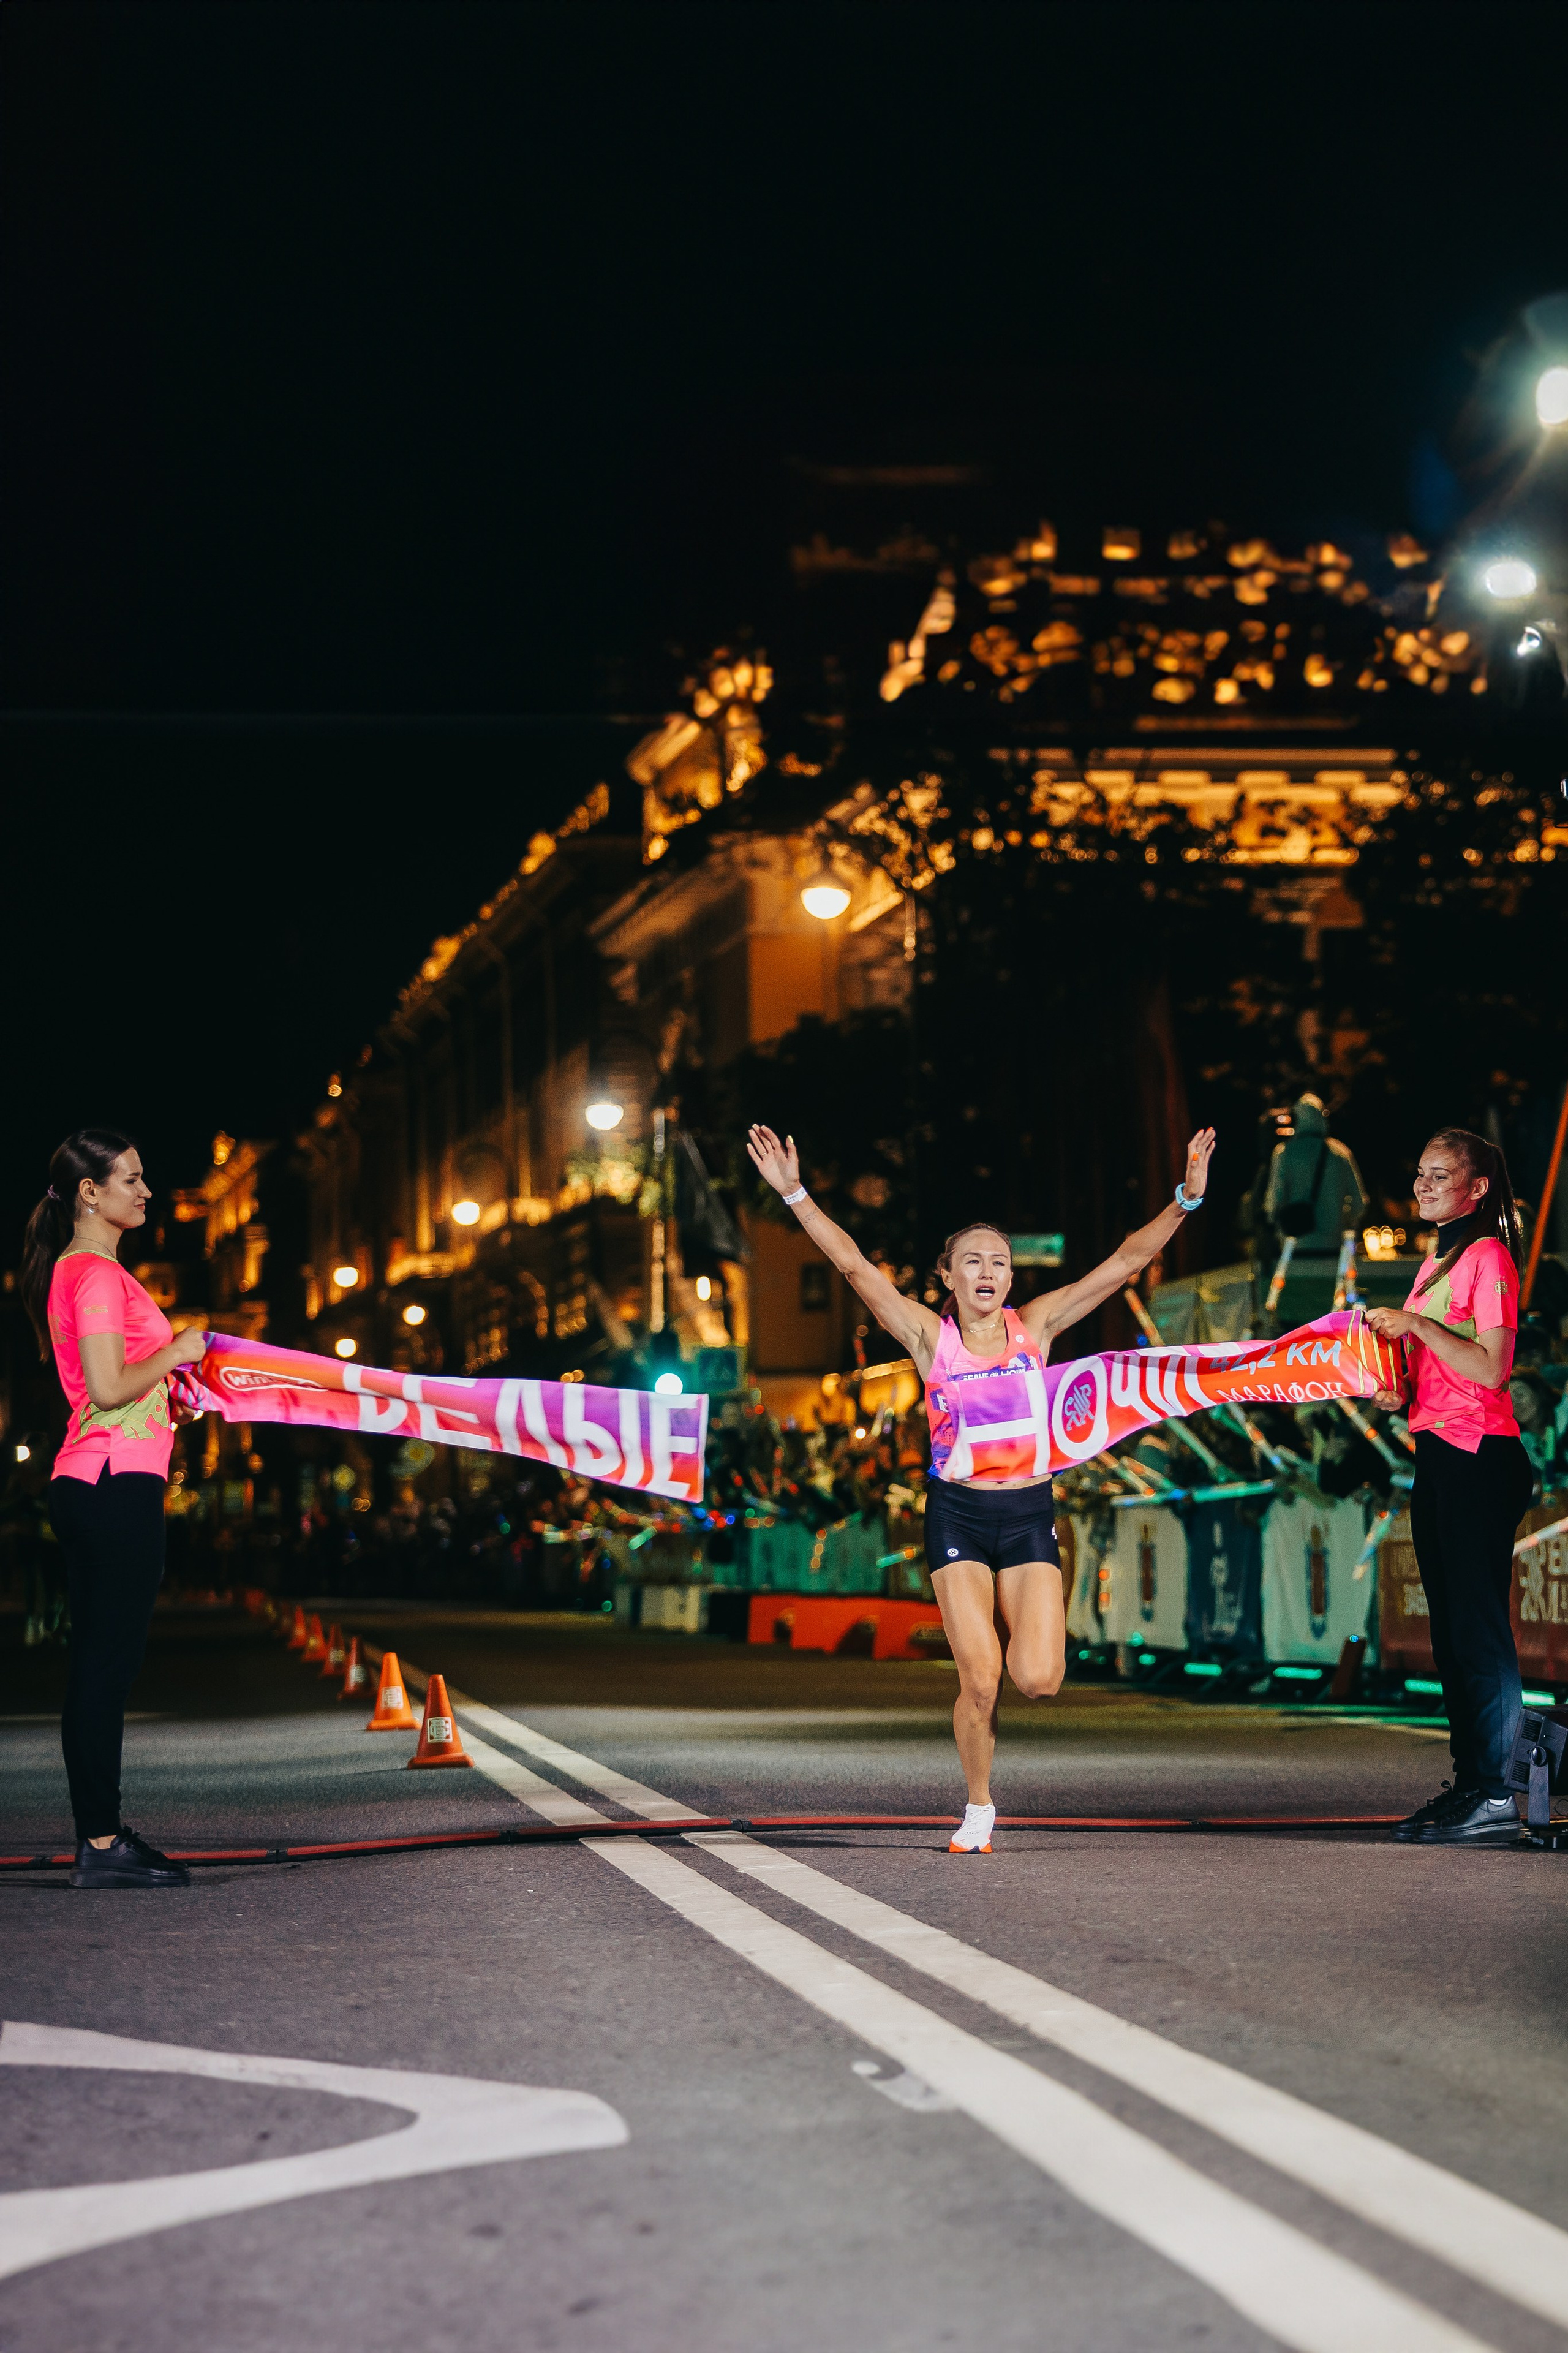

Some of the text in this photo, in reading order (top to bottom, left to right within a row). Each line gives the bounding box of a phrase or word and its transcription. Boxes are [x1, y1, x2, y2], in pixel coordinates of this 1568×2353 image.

[344, 1364, 699, 1497] БЕЛЫЕ
[943, 1353, 1218, 1480] НОЧИ
[1215, 1381, 1348, 1403] МАРАФОН
